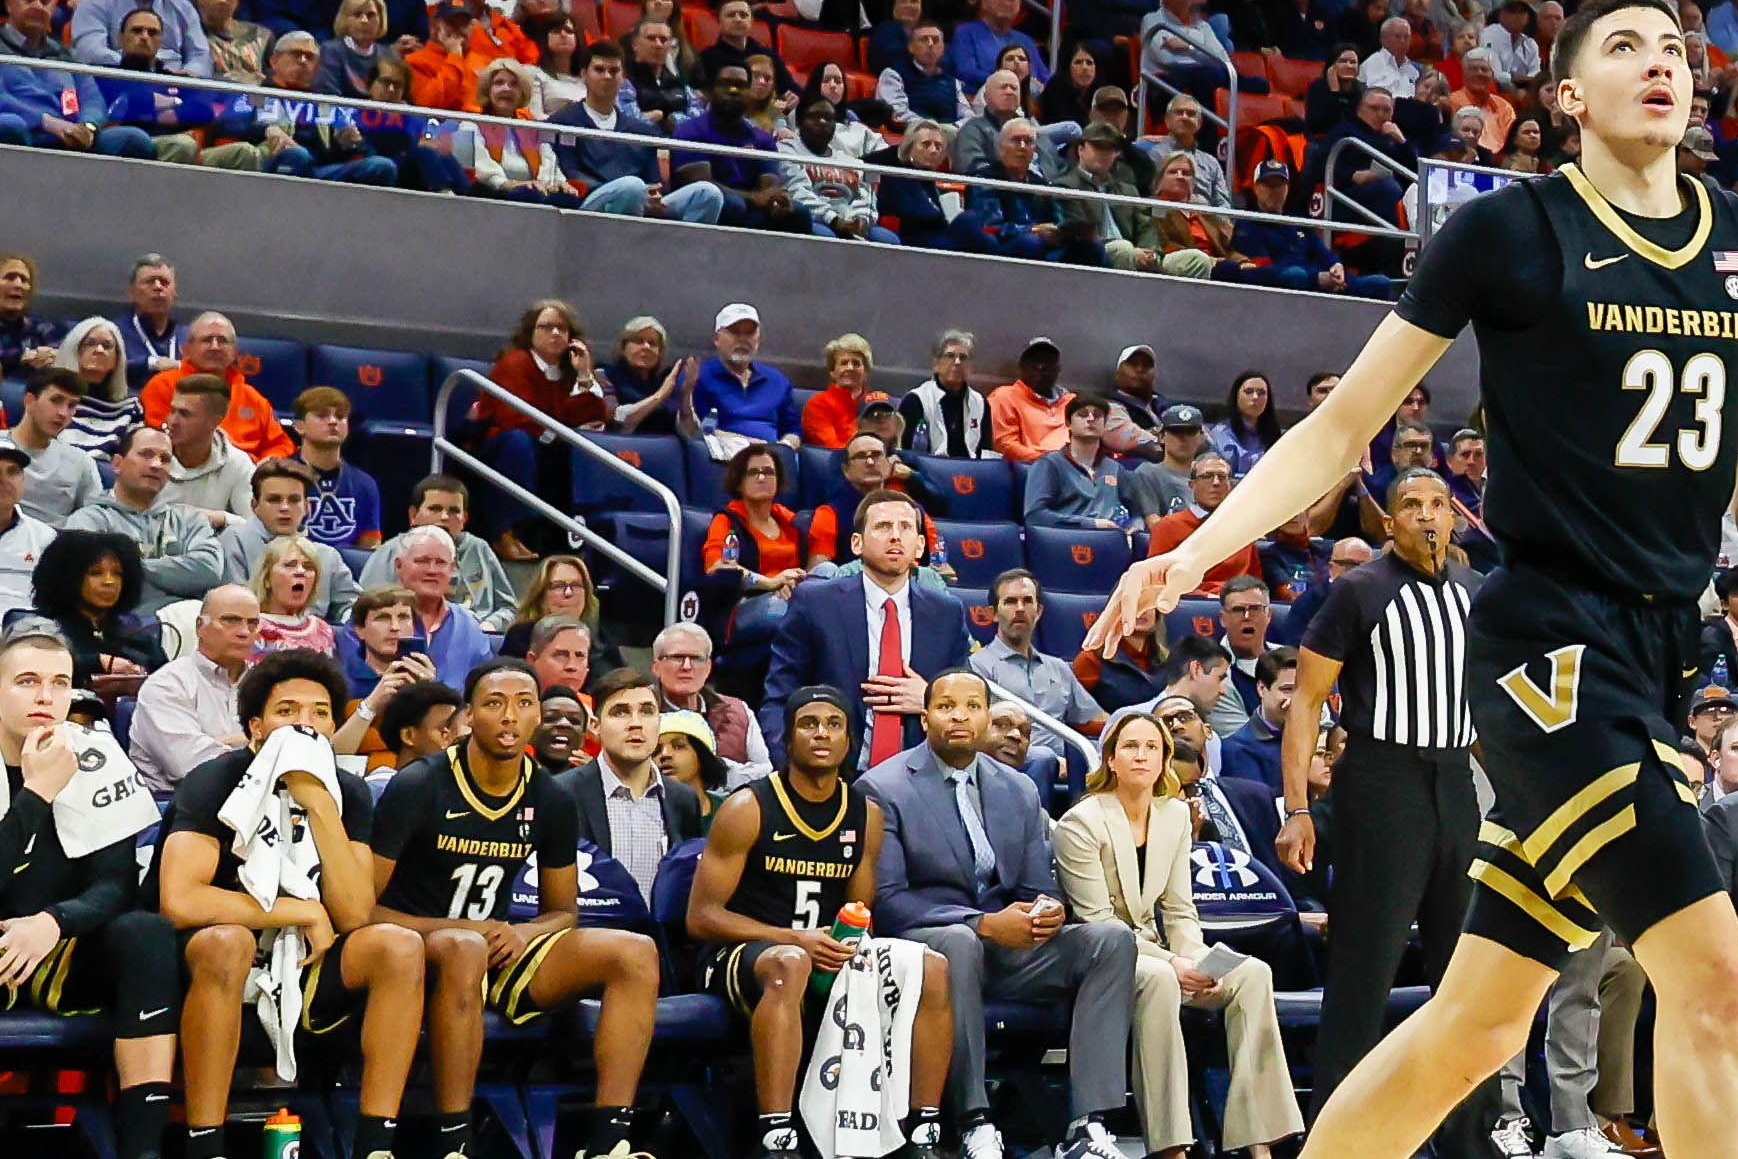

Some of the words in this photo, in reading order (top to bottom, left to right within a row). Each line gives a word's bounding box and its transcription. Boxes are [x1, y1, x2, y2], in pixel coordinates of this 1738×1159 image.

[1614, 349, 1727, 471] 23
[1495, 644, 1587, 734] V
[436, 833, 533, 859] VANDERBILT
[765, 855, 854, 879] VANDERBILT
[447, 862, 505, 921] 13
[791, 880, 822, 931] 5
[1229, 892, 1278, 900] ARMOUR
